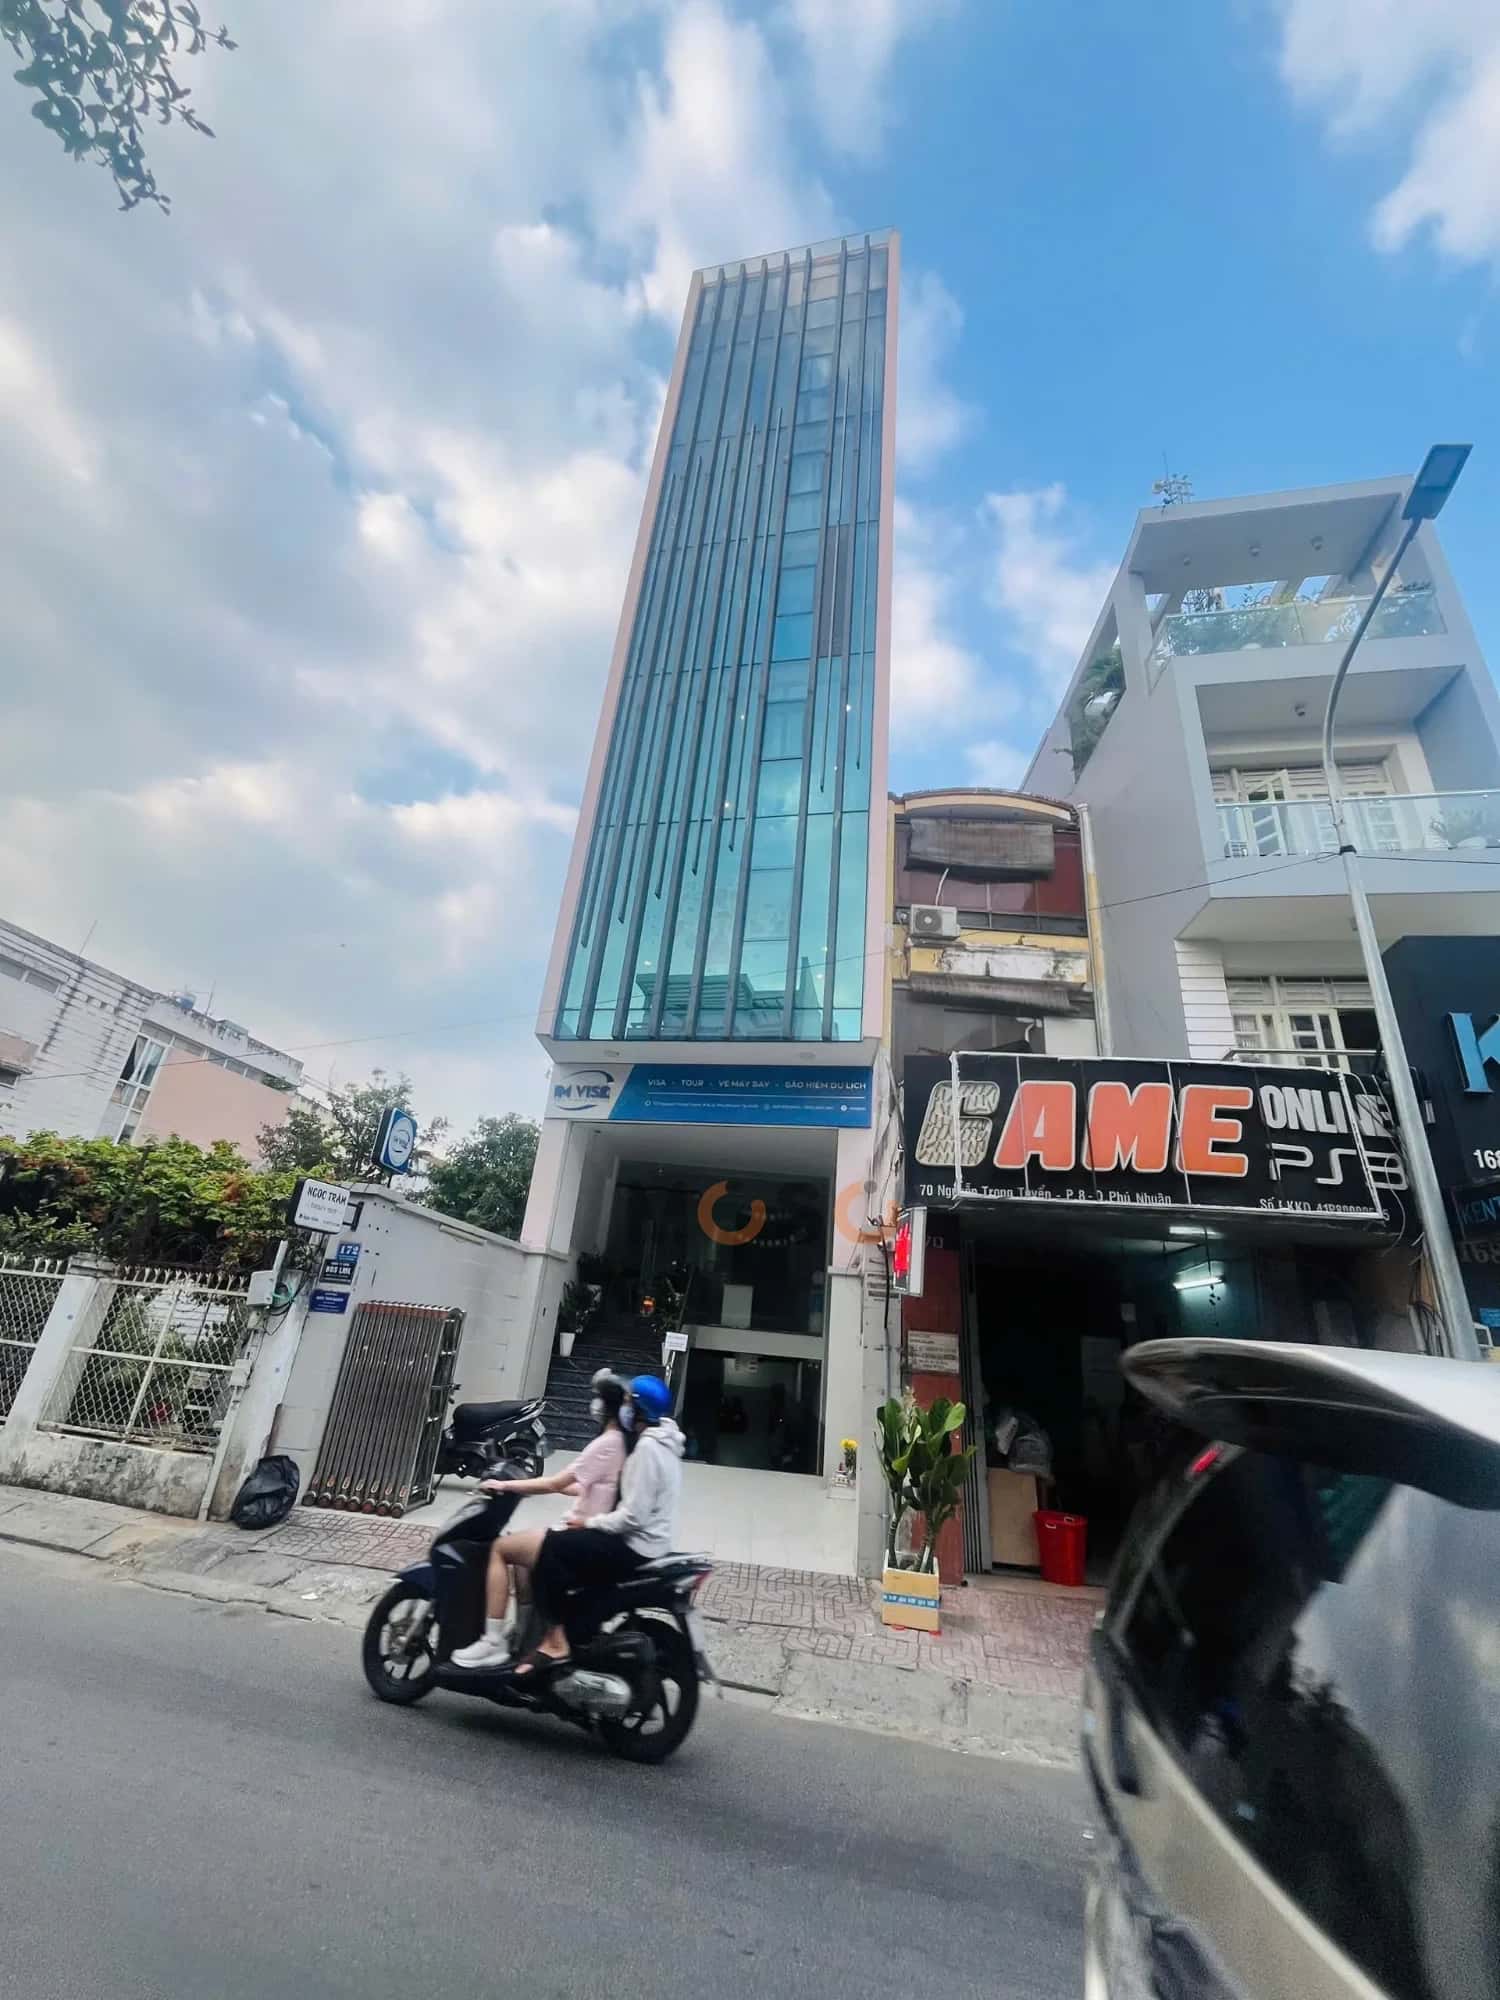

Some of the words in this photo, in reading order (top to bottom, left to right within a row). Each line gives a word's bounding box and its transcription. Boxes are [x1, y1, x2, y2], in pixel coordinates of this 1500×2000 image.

[648, 1079, 666, 1087] VISA
[681, 1079, 704, 1087] TOUR
[914, 1080, 1253, 1177] GAME
[1260, 1085, 1395, 1137] ONLINE
[919, 1184, 934, 1196] 70
[1266, 1143, 1408, 1191] PS3
